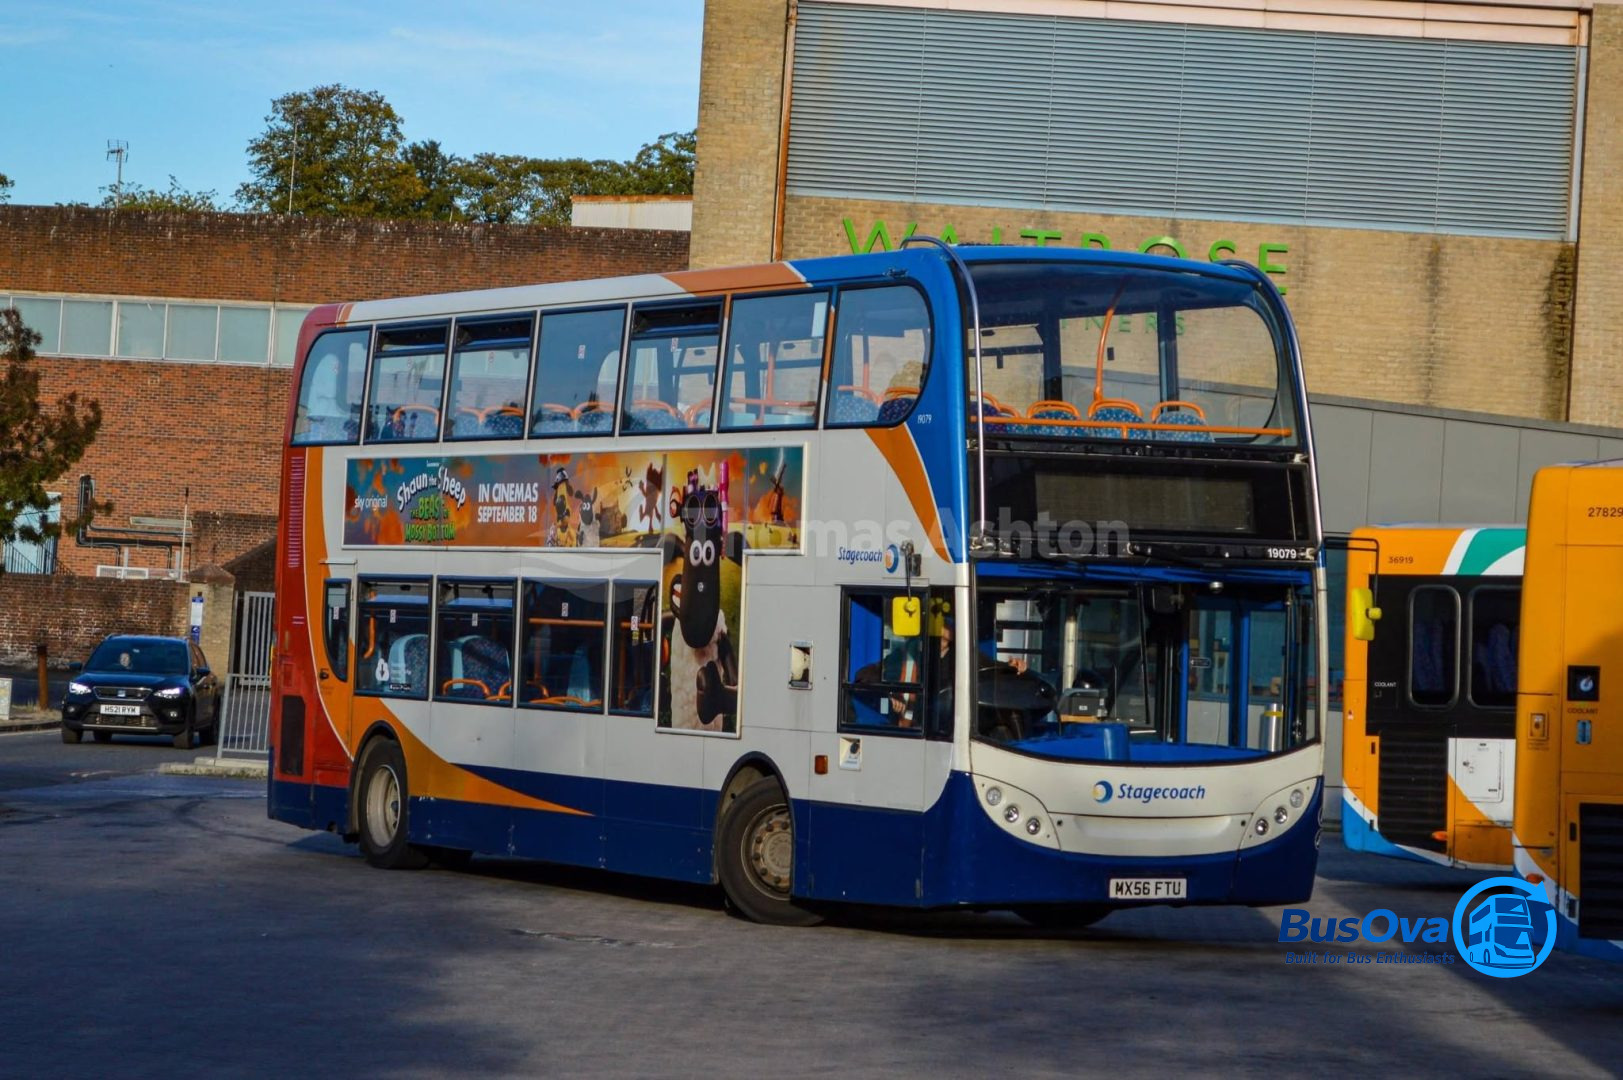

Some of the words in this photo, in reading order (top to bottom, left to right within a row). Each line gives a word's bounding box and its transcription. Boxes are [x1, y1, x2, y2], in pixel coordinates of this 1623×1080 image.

[397, 473, 427, 511] Shaun
[438, 464, 466, 508] Sheep
[478, 483, 490, 502] IN
[492, 482, 539, 503] CINEMAS
[354, 495, 365, 511] sky
[365, 494, 388, 512] original
[1588, 506, 1623, 518] 27829
[477, 506, 525, 523] SEPTEMBER
[528, 505, 538, 523] 18
[838, 546, 883, 568] Stagecoach
[1267, 547, 1297, 559] 19079
[1388, 556, 1414, 565] 36919
[1117, 783, 1206, 803] Stagecoach
[1115, 881, 1150, 896] MX56
[1154, 881, 1181, 896] FTU
